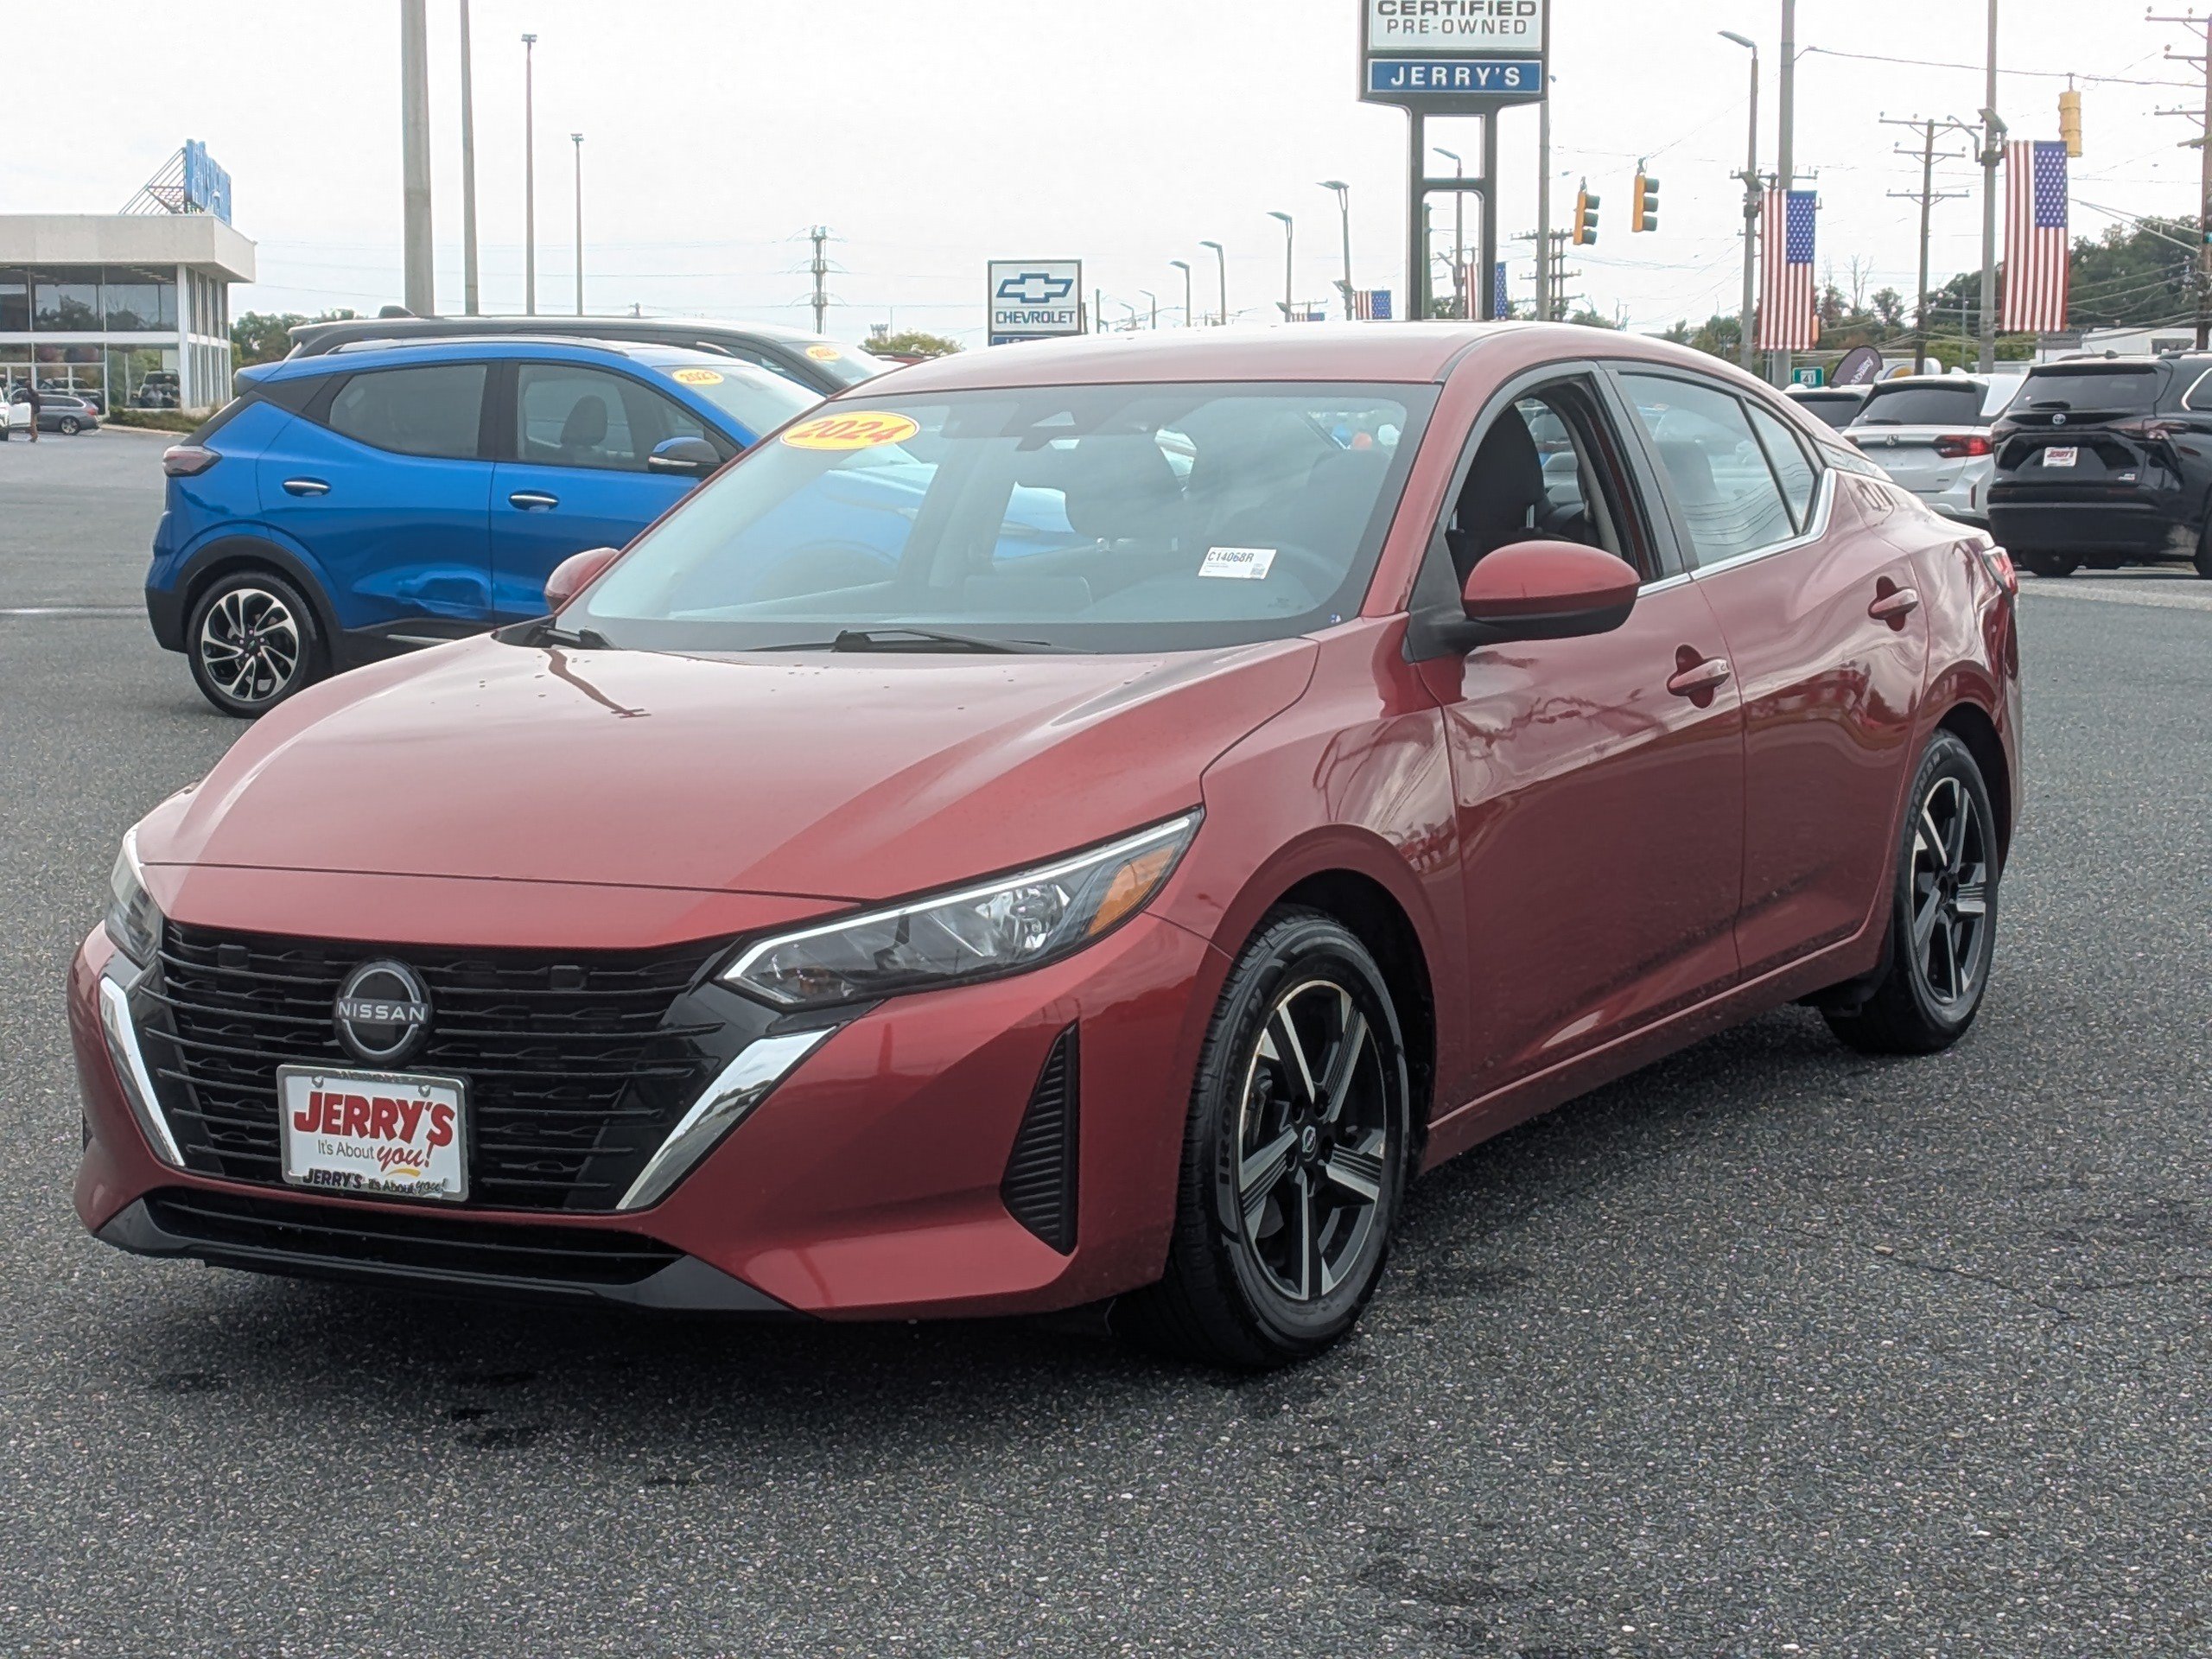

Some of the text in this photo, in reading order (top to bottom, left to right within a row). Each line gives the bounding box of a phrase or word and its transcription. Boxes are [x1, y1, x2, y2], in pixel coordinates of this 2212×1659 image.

[1377, 0, 1537, 16] CERTIFIED
[1387, 19, 1527, 35] PRE-OWNED
[1390, 67, 1521, 86] JERRY'S
[995, 310, 1076, 324] CHEVROLET
[787, 420, 912, 442] 2024
[1207, 551, 1255, 563] C14068R
[337, 1001, 427, 1022] NISSAN
[293, 1090, 456, 1147] JERRY'S
[317, 1140, 433, 1173] It's About you!
[302, 1167, 364, 1189] JERRY'S
[383, 1179, 416, 1194] About
